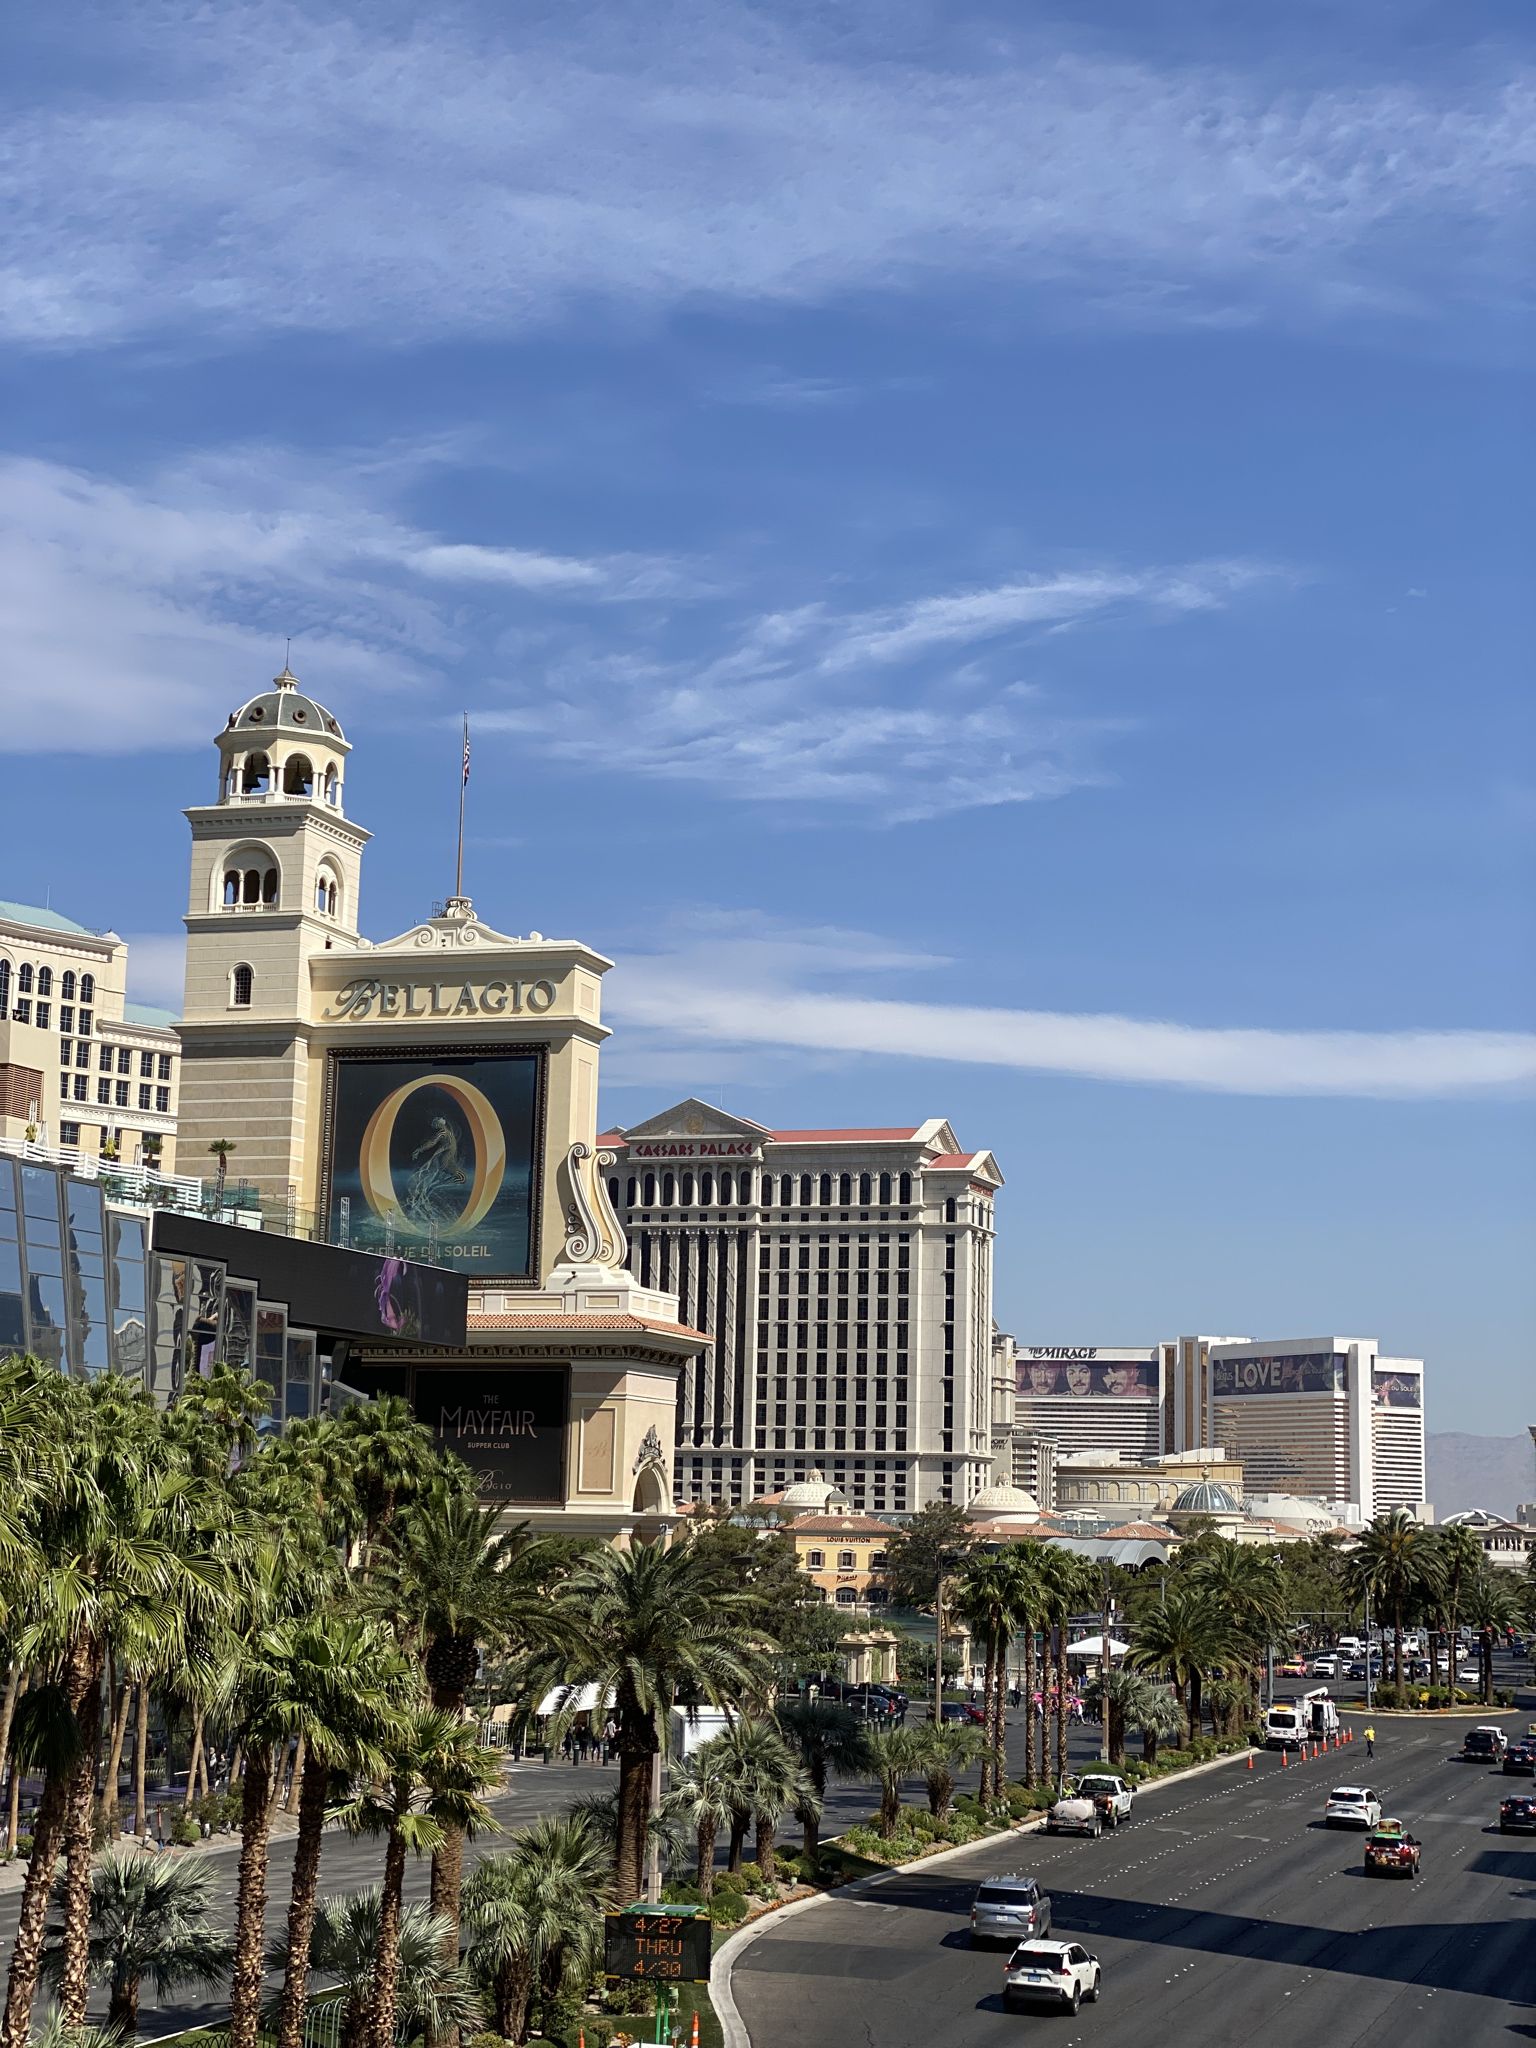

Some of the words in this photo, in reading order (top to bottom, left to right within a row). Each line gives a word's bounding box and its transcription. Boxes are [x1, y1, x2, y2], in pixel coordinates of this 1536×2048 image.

[323, 978, 557, 1019] BELLAGIO
[635, 1144, 695, 1156] CAESARS
[700, 1142, 752, 1155] PALACE
[444, 1245, 491, 1257] SOLEIL
[1033, 1348, 1097, 1359] MIRAGE
[1235, 1362, 1281, 1388] LOVE
[483, 1394, 499, 1404] THE
[440, 1406, 538, 1438] MAYFAIR
[635, 1917, 682, 1934] 4/27
[635, 1938, 682, 1955] THRU
[634, 1960, 681, 1977] 4/30
